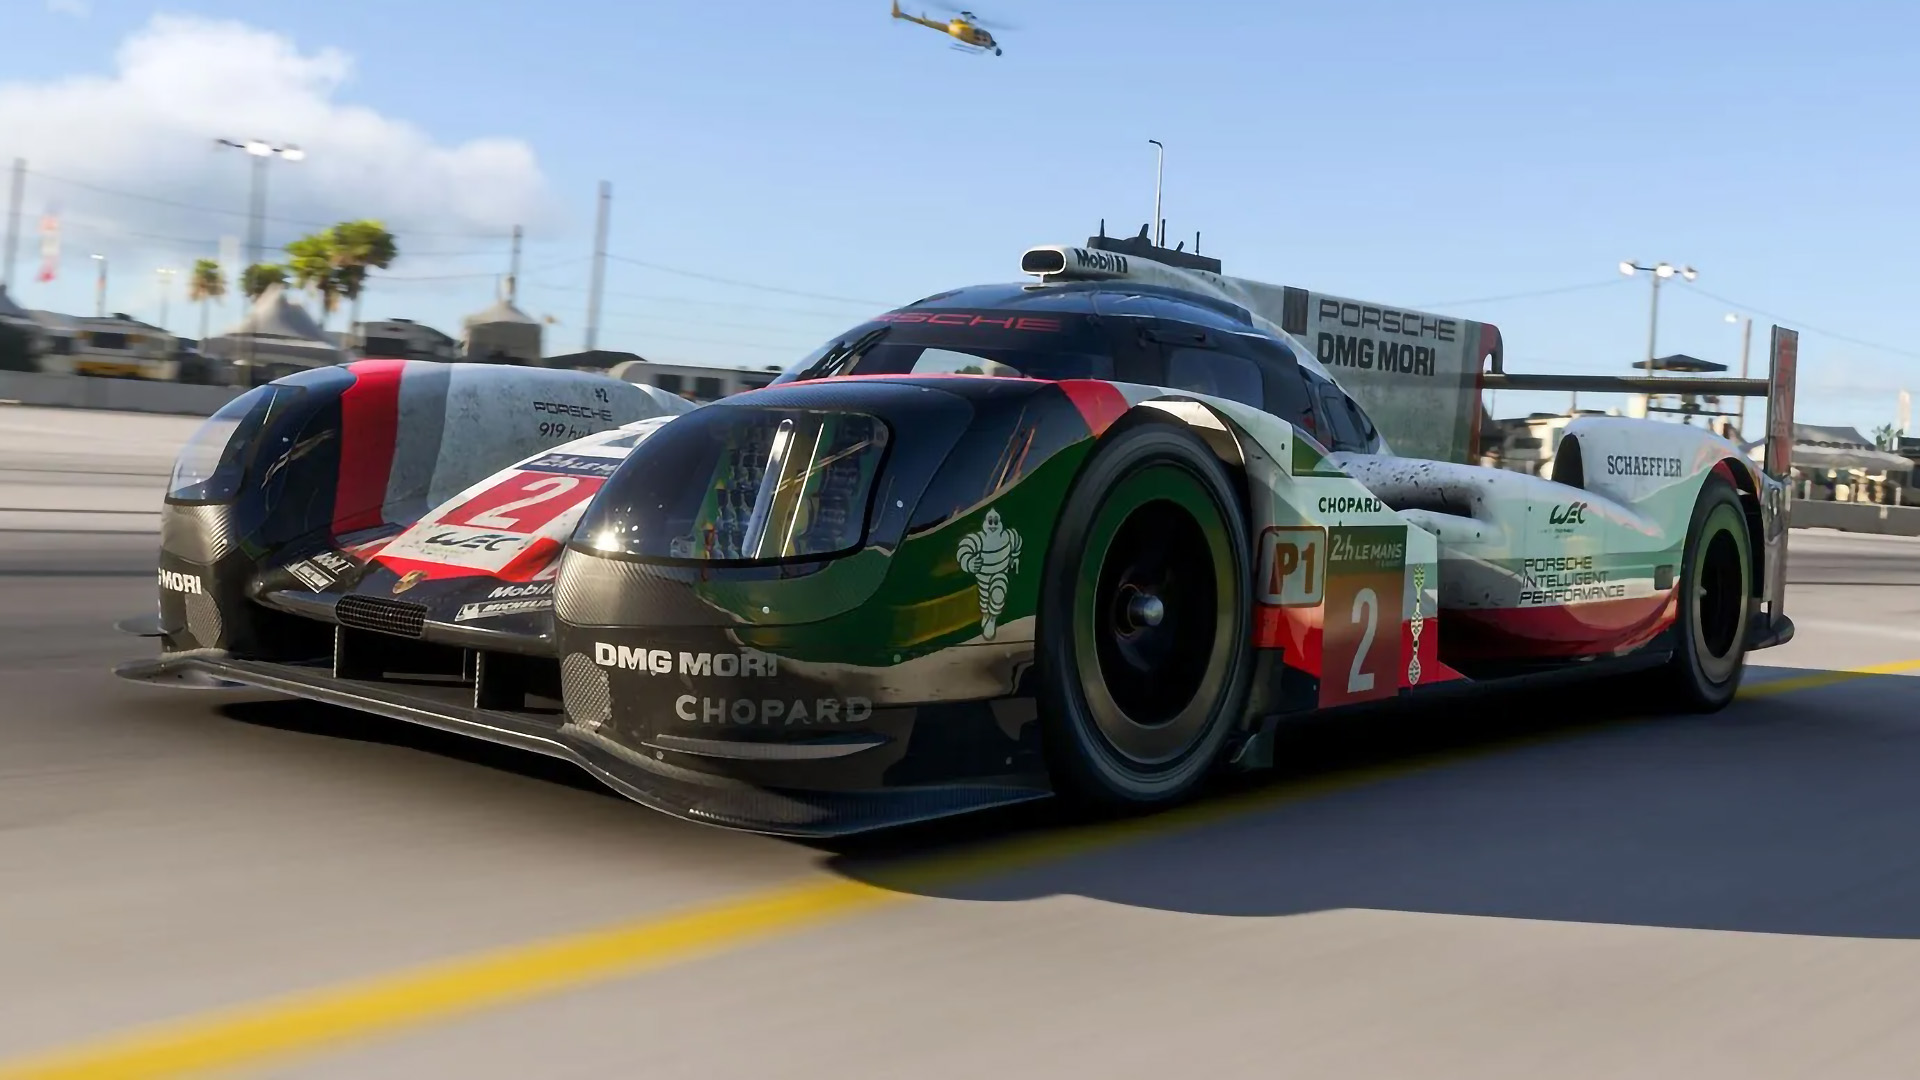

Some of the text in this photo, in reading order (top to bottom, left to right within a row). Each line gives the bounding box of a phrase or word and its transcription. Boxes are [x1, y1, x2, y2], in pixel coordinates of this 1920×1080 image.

[1073, 248, 1114, 271] Mobil
[870, 312, 1062, 332] SCHE
[1318, 299, 1456, 342] PORSCHE
[1317, 332, 1436, 376] DMG MORI
[533, 401, 613, 421] PORSCHE
[539, 422, 566, 438] 919
[1607, 455, 1682, 477] SCHAEFFLER
[464, 476, 580, 528] 2
[1318, 497, 1382, 512] CHOPARD
[1549, 501, 1588, 525] WEC
[424, 531, 522, 551] WEC
[1355, 545, 1370, 560] LE
[1370, 543, 1402, 559] MANS
[1269, 542, 1316, 595] P1
[1524, 556, 1592, 571] PORSCHE
[161, 569, 202, 595] MORI
[1522, 570, 1609, 588] INTELLIGENT
[1519, 584, 1625, 604] PERFORMANCE
[1347, 588, 1378, 693] 2
[595, 642, 778, 677] DMG MORI
[676, 694, 872, 726] CHOPARD
